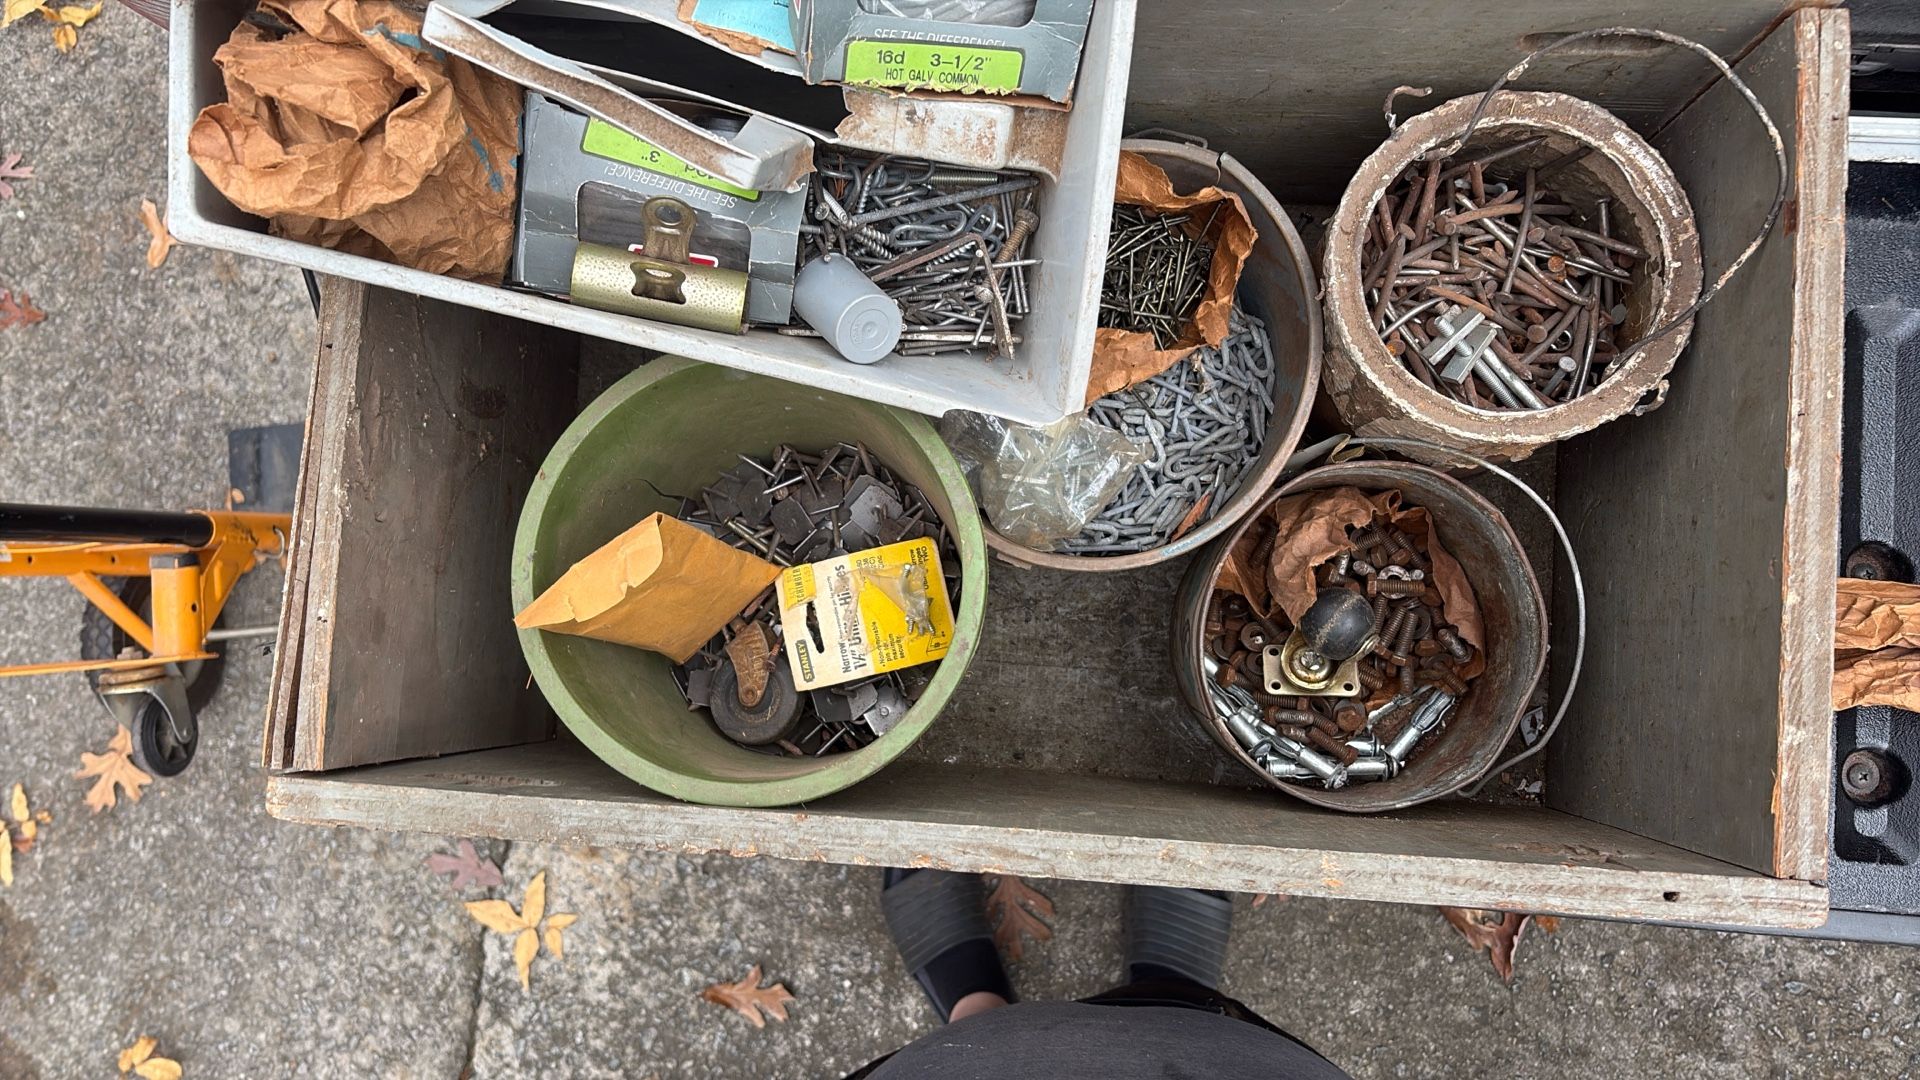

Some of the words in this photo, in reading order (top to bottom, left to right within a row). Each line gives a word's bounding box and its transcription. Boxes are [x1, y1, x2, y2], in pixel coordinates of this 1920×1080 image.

[874, 28, 898, 39] SEE
[900, 30, 925, 41] THE
[877, 49, 906, 65] 16d
[885, 67, 905, 80] HOT
[908, 69, 934, 82] GALV
[939, 72, 980, 85] COMMON
[641, 150, 661, 164] 3"
[604, 162, 685, 194] DIFFERENCE!
[687, 186, 711, 202] THE
[713, 194, 738, 209] SEE
[921, 545, 929, 563] TWO
[835, 564, 853, 607] Hies
[888, 633, 898, 661] maximum
[797, 640, 814, 682] STANLEY
[839, 642, 852, 674] Narrow
